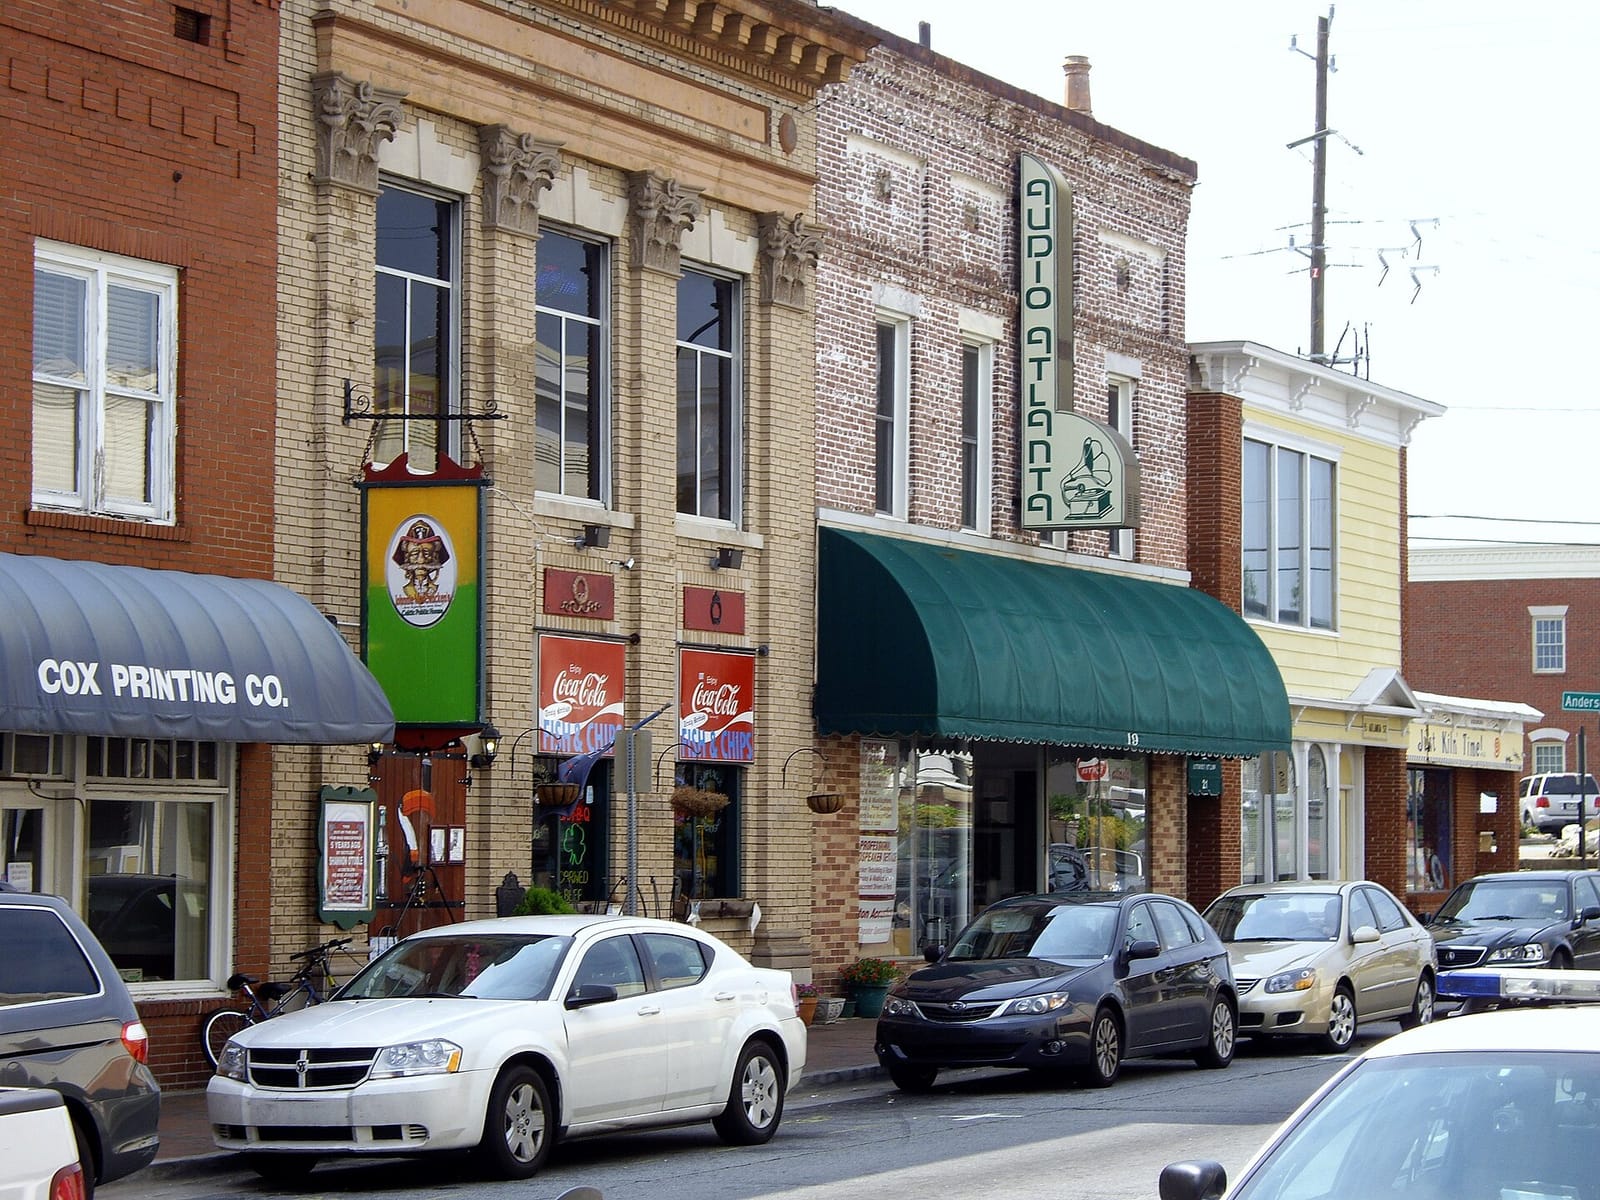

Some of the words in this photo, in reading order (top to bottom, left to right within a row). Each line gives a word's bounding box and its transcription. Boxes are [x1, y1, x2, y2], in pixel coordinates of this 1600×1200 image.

[1025, 178, 1053, 310] AUDIO
[1026, 326, 1053, 522] ATLANTA
[38, 659, 102, 695] COX
[110, 663, 237, 705] PRINTING
[245, 674, 289, 707] CO.
[553, 670, 608, 707] Coca-Cola
[691, 681, 741, 716] Coca-Cola
[542, 719, 571, 753] FISH
[573, 721, 583, 754] &
[586, 721, 623, 753] CHIP
[680, 728, 707, 758] FISH
[709, 729, 718, 759] &
[720, 730, 753, 760] CHIPS
[1127, 732, 1139, 746] 19
[335, 841, 350, 849] YEARS
